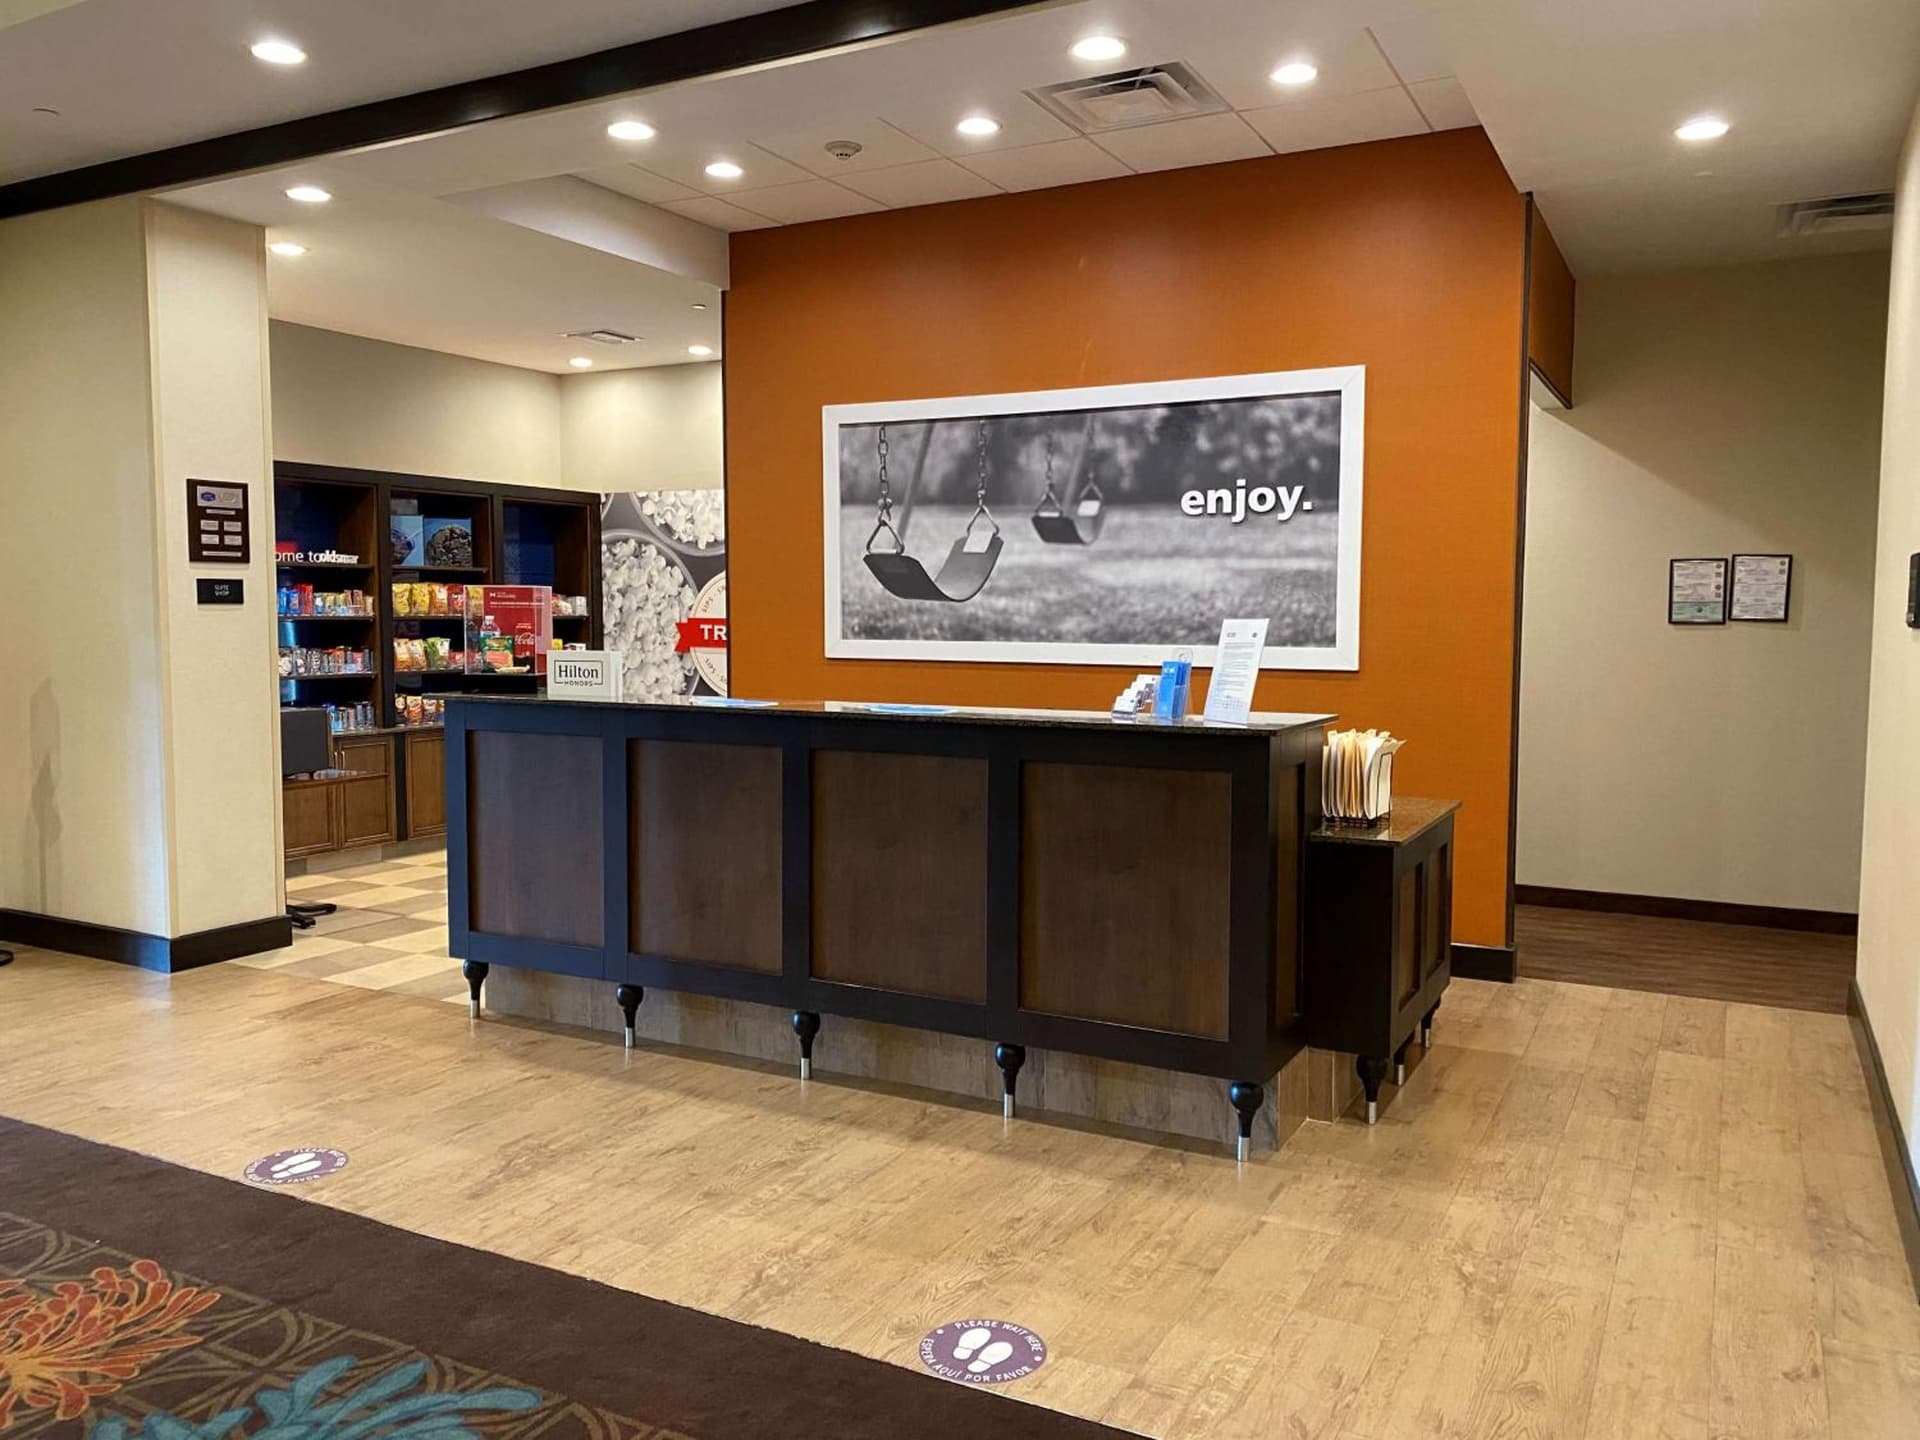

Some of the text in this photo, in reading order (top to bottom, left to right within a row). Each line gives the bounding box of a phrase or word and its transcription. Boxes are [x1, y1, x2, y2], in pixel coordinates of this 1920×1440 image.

[1180, 478, 1313, 523] enjoy.
[558, 664, 599, 679] Hilton
[954, 1320, 1043, 1352] PLEASE WAIT HERE
[963, 1373, 991, 1382] POR
[996, 1366, 1032, 1381] FAVOR
